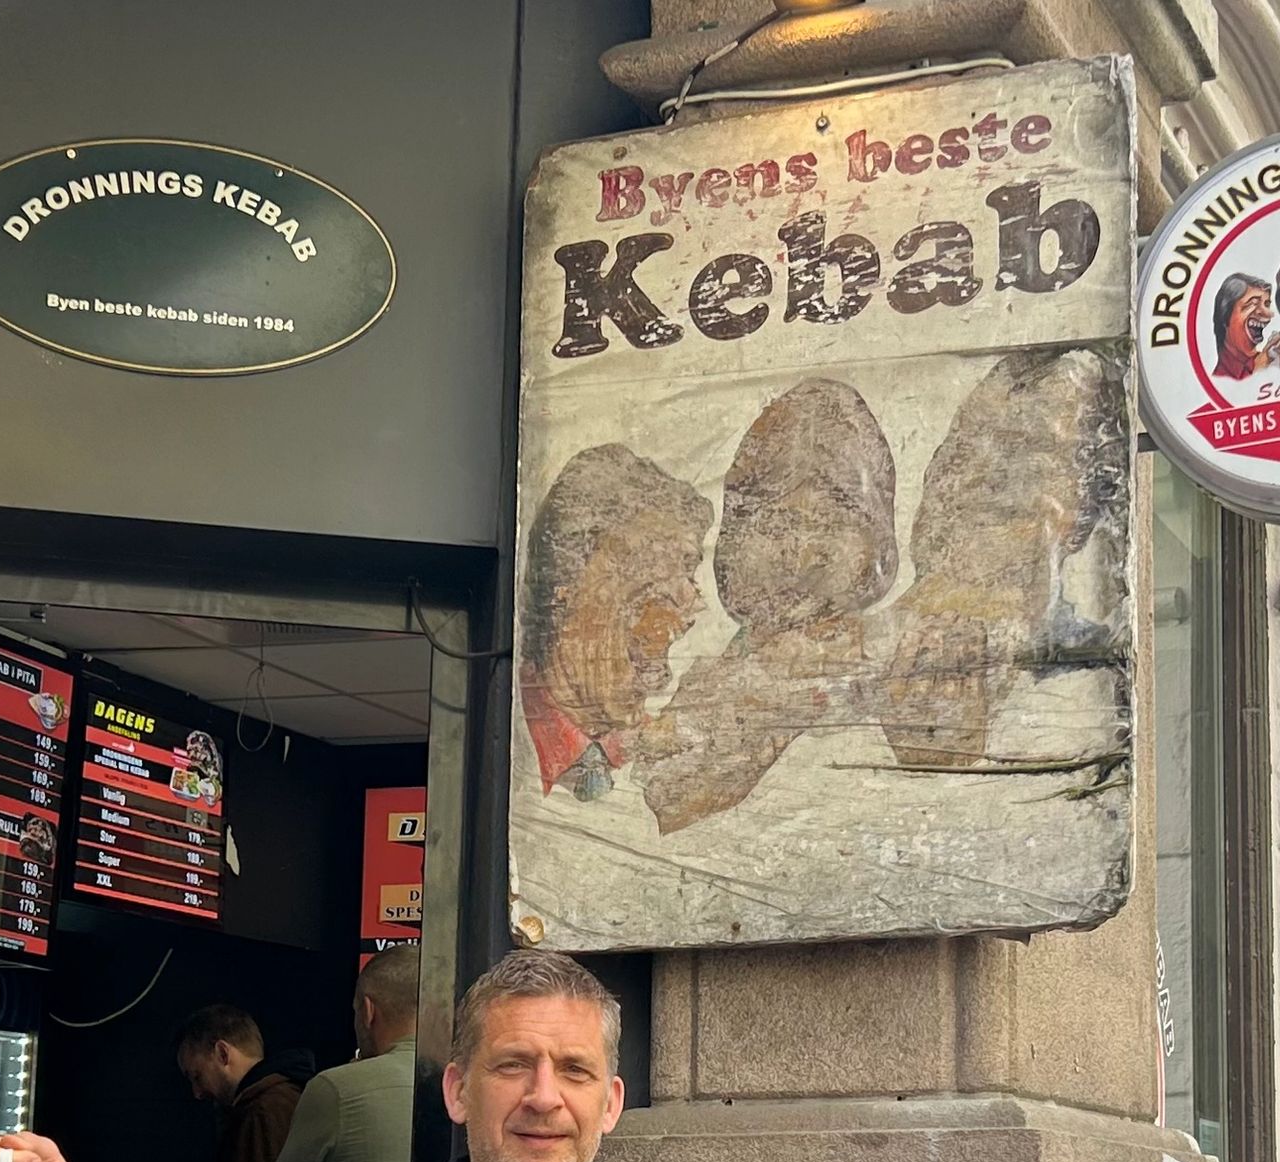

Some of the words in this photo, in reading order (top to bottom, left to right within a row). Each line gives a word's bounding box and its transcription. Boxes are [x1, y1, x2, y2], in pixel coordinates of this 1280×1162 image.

[597, 152, 818, 225] Byens
[844, 111, 1053, 184] beste
[2, 170, 204, 242] DRONNINGS
[213, 181, 318, 264] KEBAB
[551, 180, 1101, 359] Kebab
[46, 293, 90, 313] Byen
[94, 298, 143, 317] beste
[147, 303, 199, 324] kebab
[203, 309, 249, 329] siden
[253, 315, 295, 333] 1984
[1213, 410, 1277, 441] BYENS
[16, 668, 36, 687] PITA
[93, 700, 156, 734] DAGENS
[35, 734, 57, 752] 149,-
[34, 752, 56, 771] 159,-
[96, 873, 113, 887] XXL
